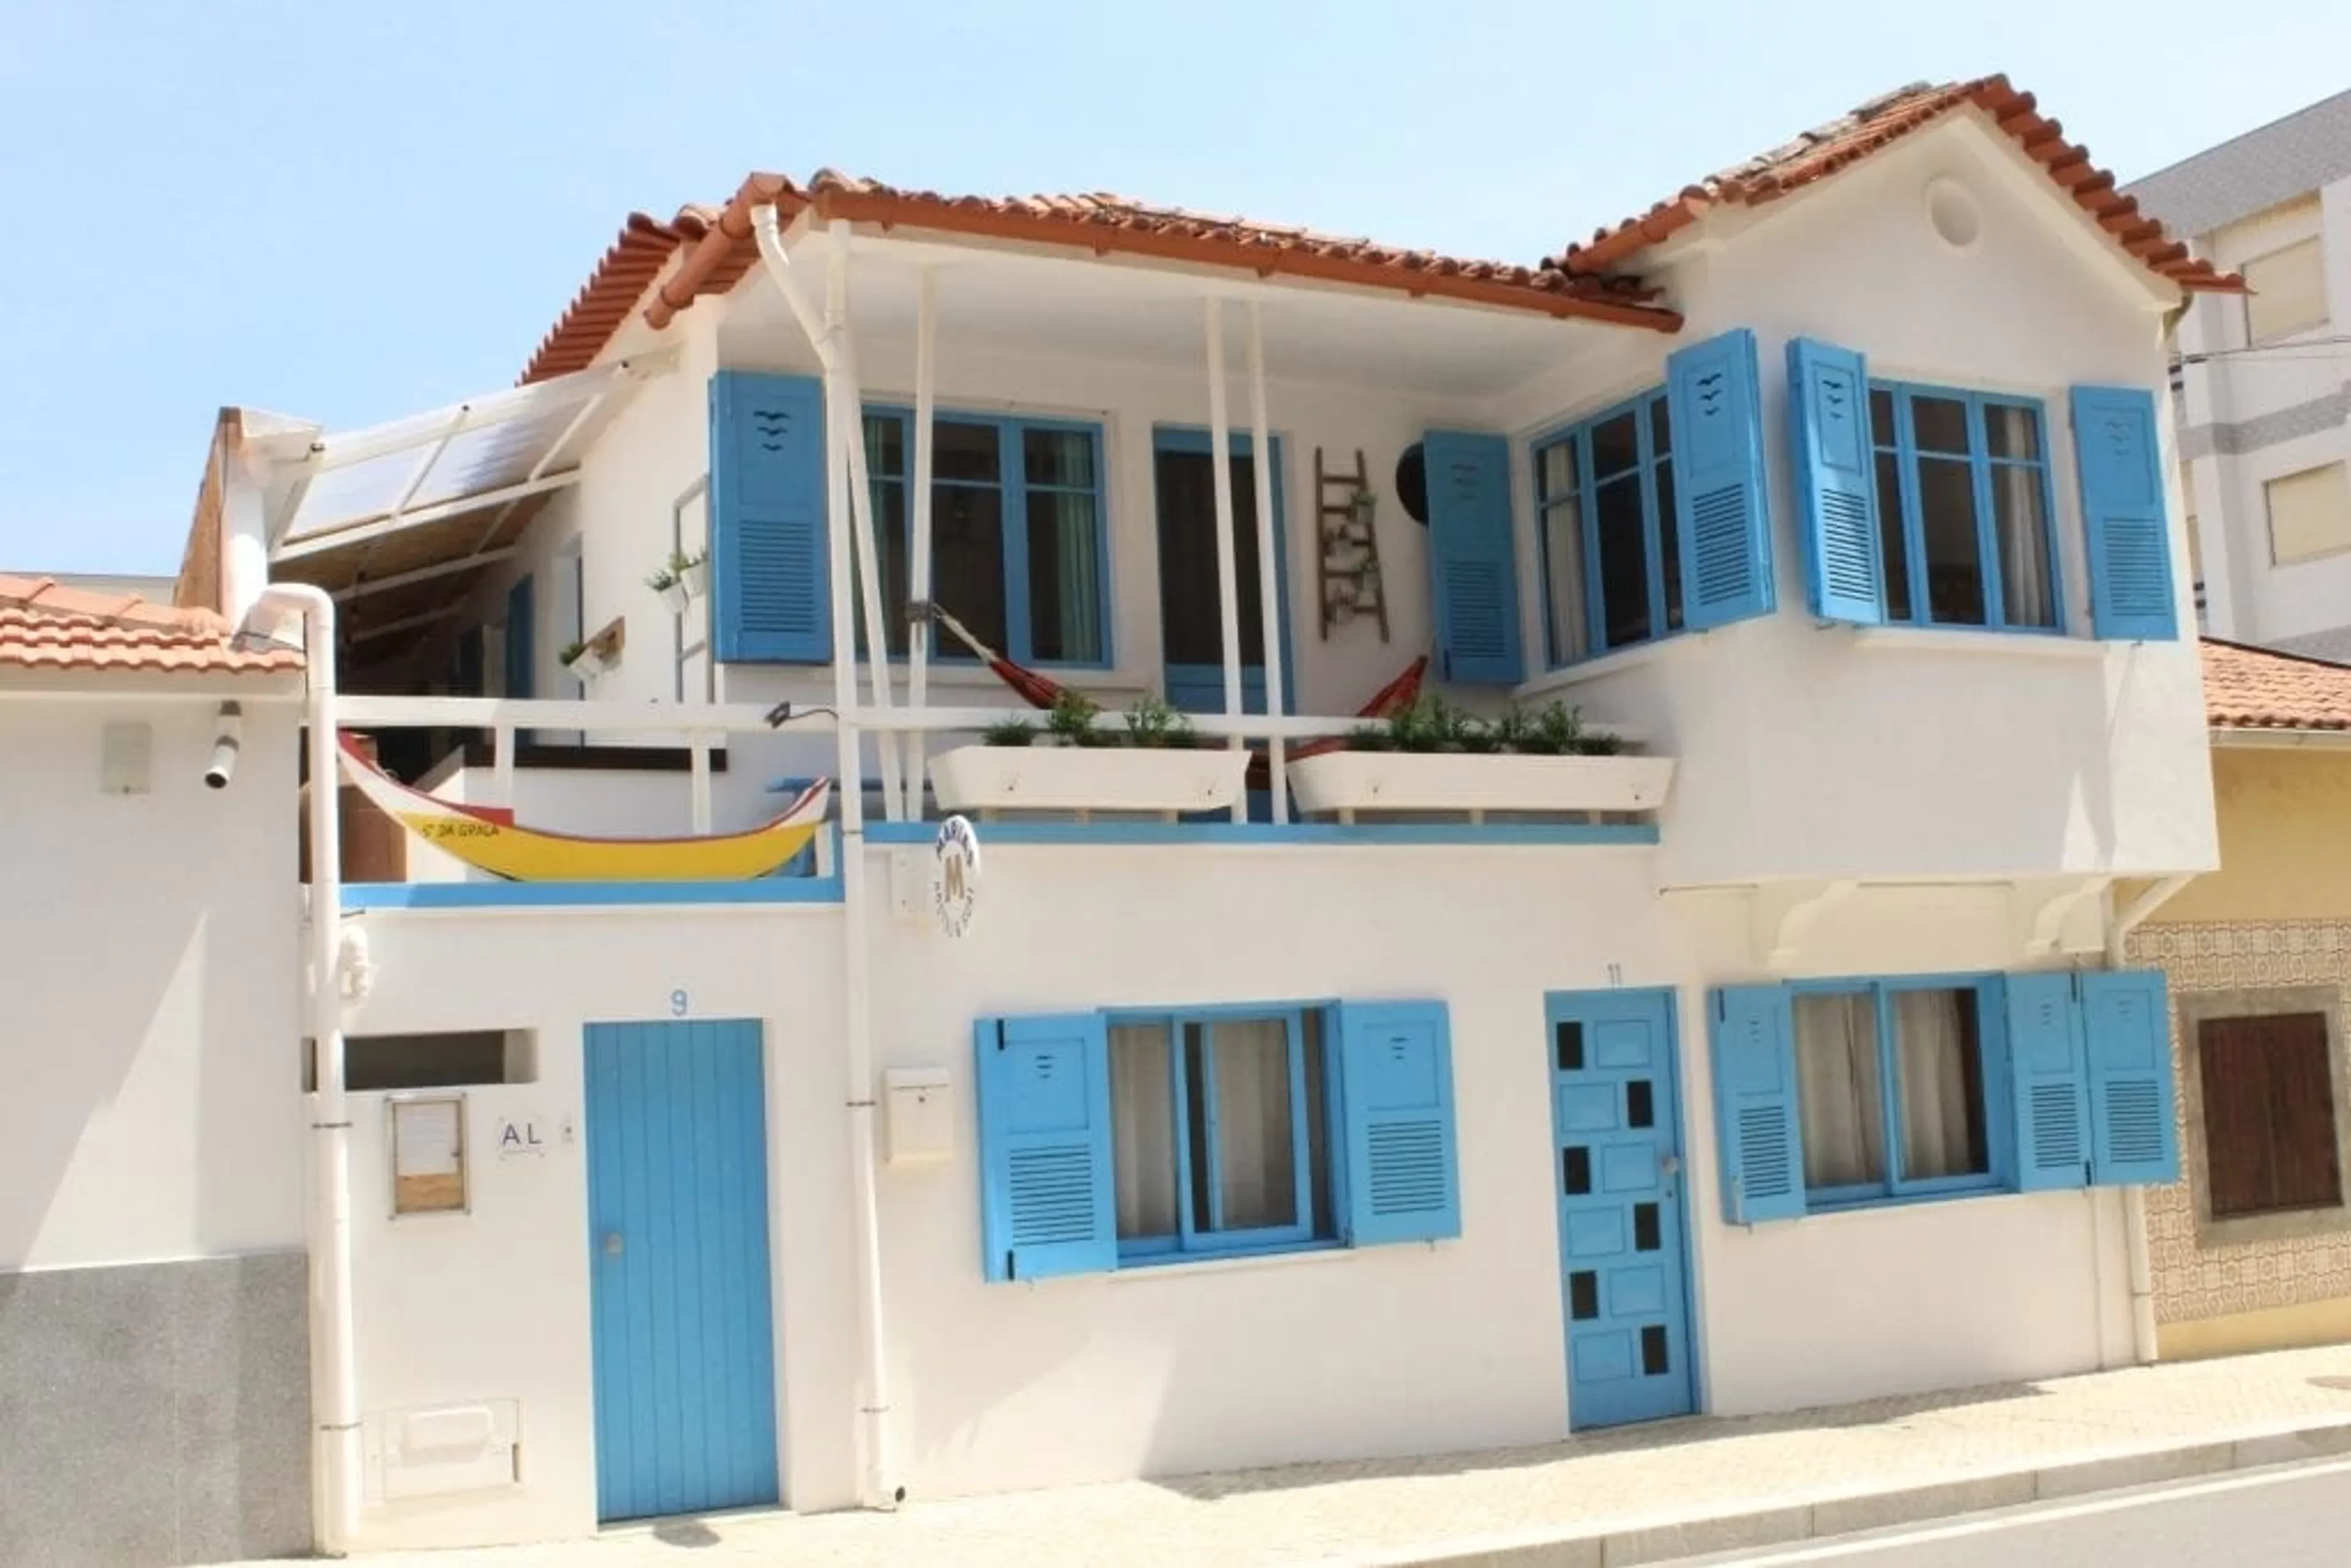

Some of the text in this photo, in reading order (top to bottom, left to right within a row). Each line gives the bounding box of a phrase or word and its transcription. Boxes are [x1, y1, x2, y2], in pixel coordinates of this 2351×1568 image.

[944, 853, 964, 902] M
[1607, 962, 1622, 987] 11
[672, 989, 687, 1017] 9
[503, 1123, 542, 1144] AL
